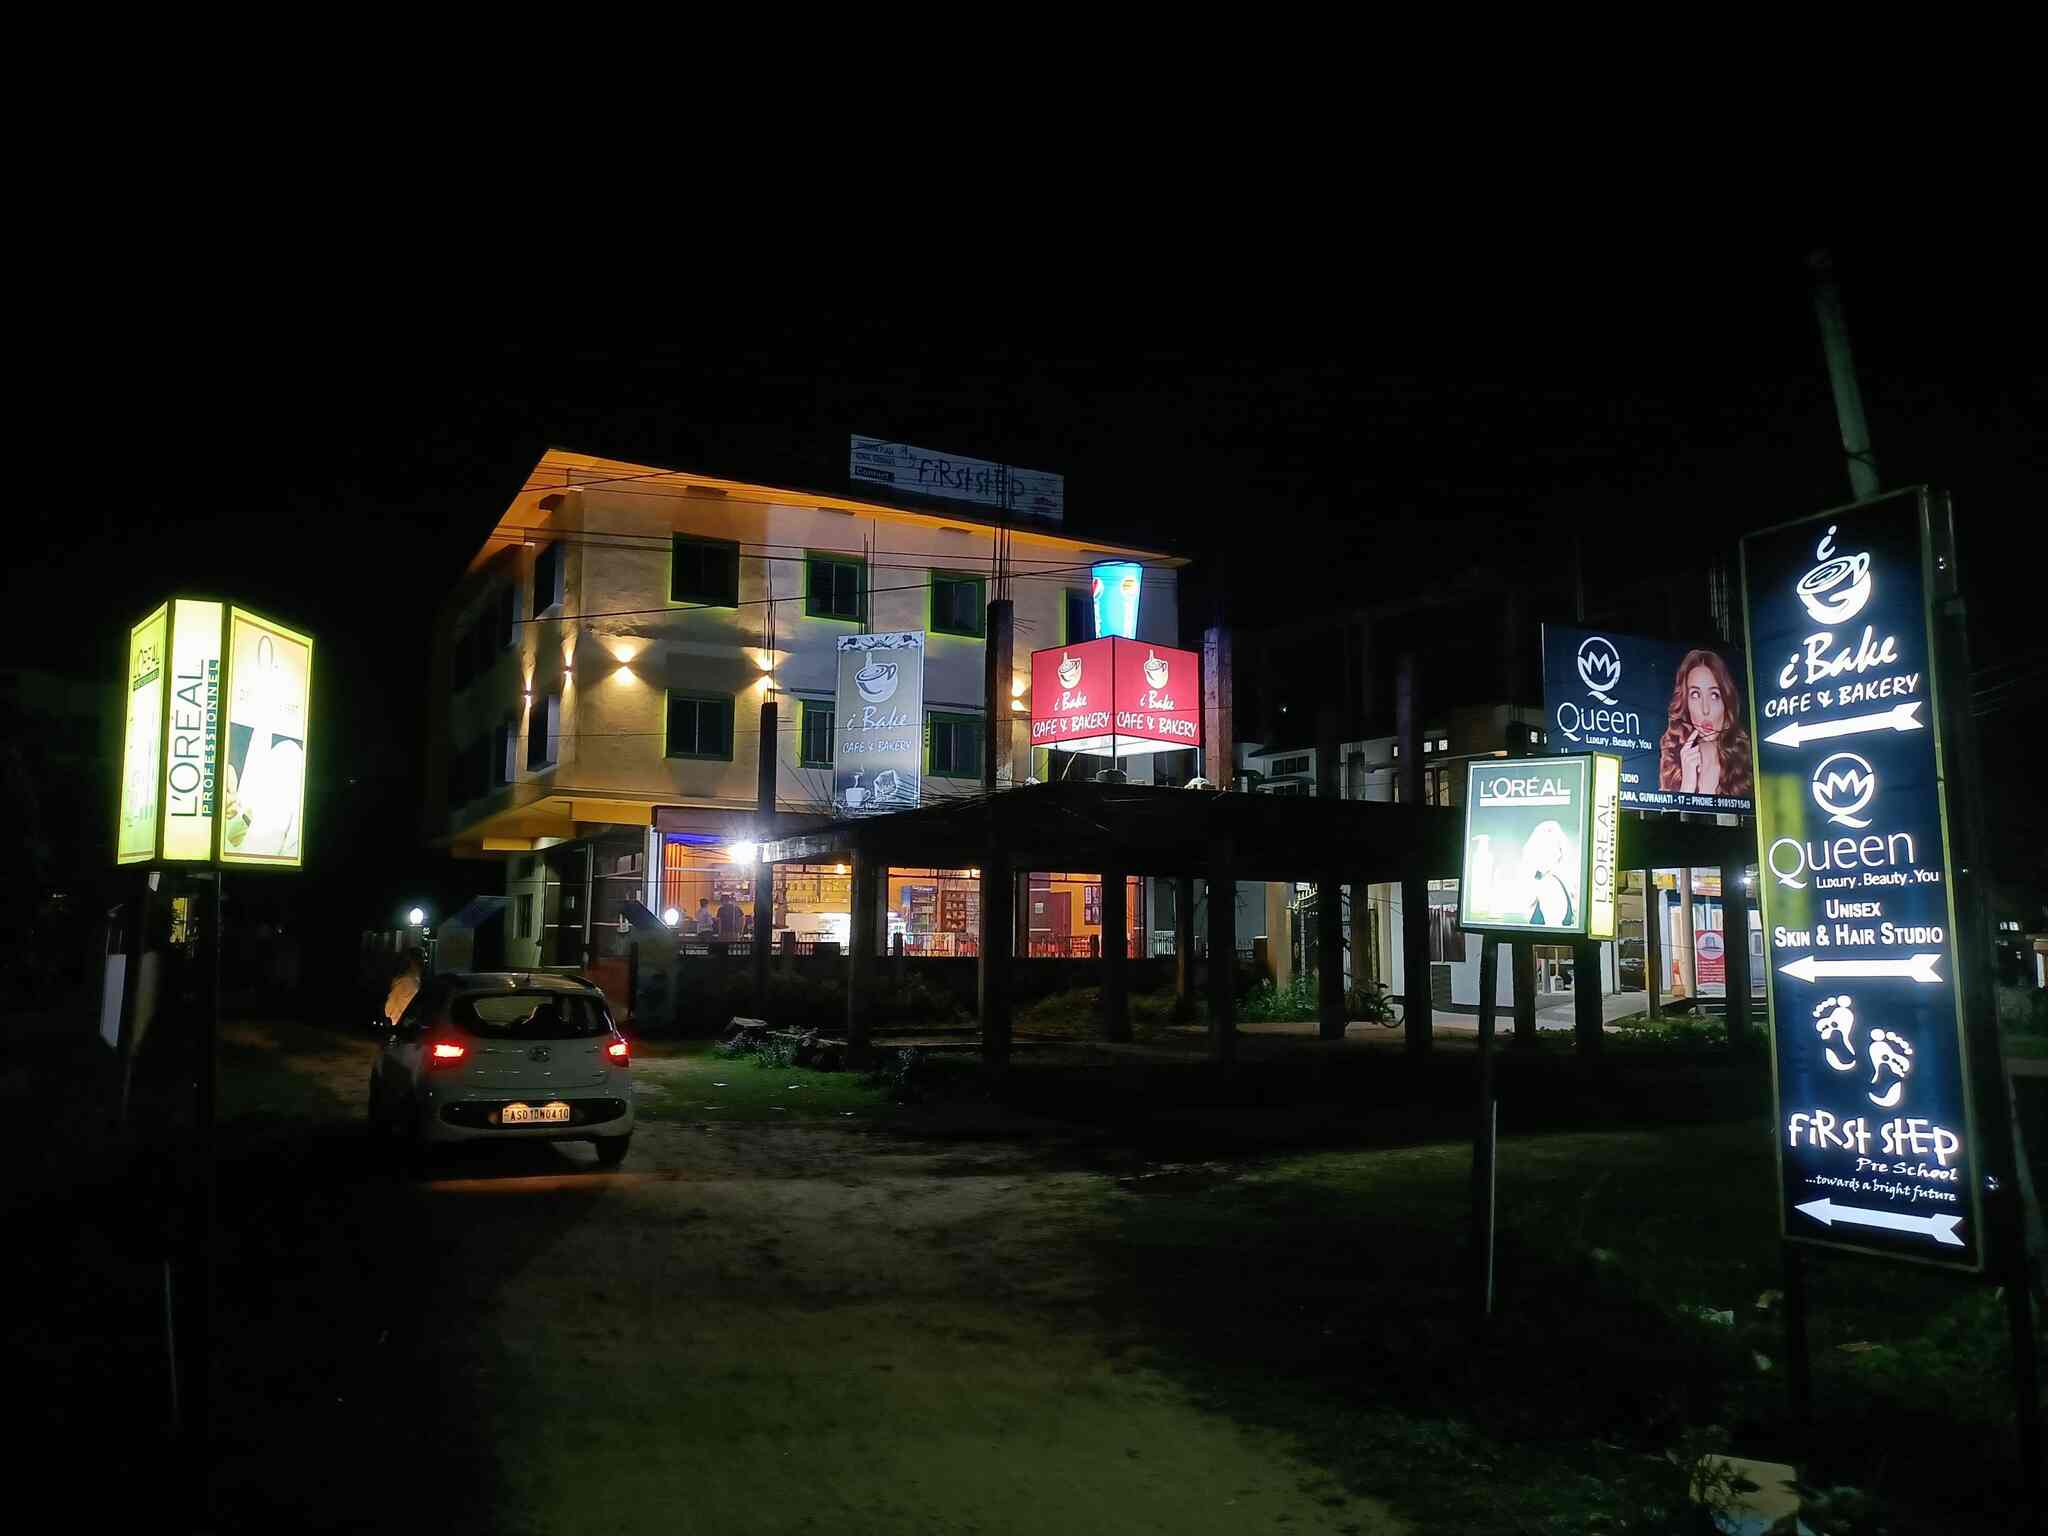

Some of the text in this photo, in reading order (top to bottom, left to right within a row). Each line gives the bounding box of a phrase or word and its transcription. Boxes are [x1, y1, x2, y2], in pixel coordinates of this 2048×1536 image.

[1764, 672, 1919, 718] CAFE & BAKERY
[1032, 718, 1058, 738] CAFE
[1071, 711, 1111, 733] BAKERY
[1116, 711, 1145, 730] CAFE
[1158, 717, 1198, 738] BAKERY
[1557, 702, 1640, 742] Queen
[201, 658, 219, 818] PROFESSIONNEL
[842, 742, 865, 753] CAFE
[1639, 738, 1652, 750] You
[1620, 773, 1640, 785] UDIO
[1768, 832, 1915, 889] Queen
[1914, 869, 1939, 882] You
[1825, 899, 1881, 919] UNISEX
[1774, 922, 1943, 948] SKIN & HAIR STUDIO
[1856, 1157, 1957, 1181] Pre School
[1862, 1181, 1871, 1190] a
[1872, 1179, 1911, 1200] bright
[1910, 1185, 1957, 1202] future
